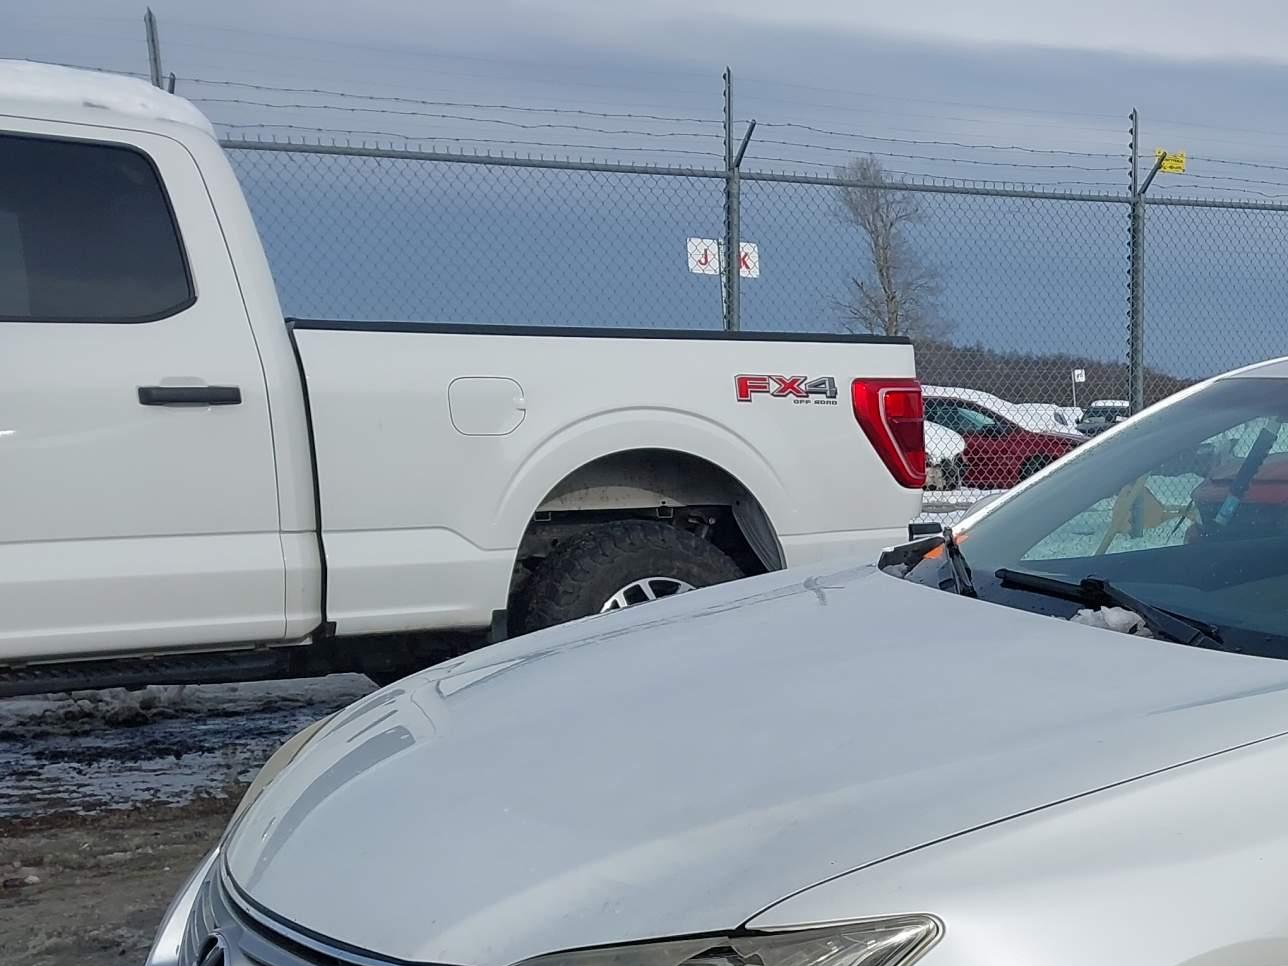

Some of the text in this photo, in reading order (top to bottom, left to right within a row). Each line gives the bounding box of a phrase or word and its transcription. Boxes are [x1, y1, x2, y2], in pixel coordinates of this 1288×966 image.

[698, 249, 708, 265] J
[737, 252, 750, 269] K
[734, 374, 838, 402] FX4
